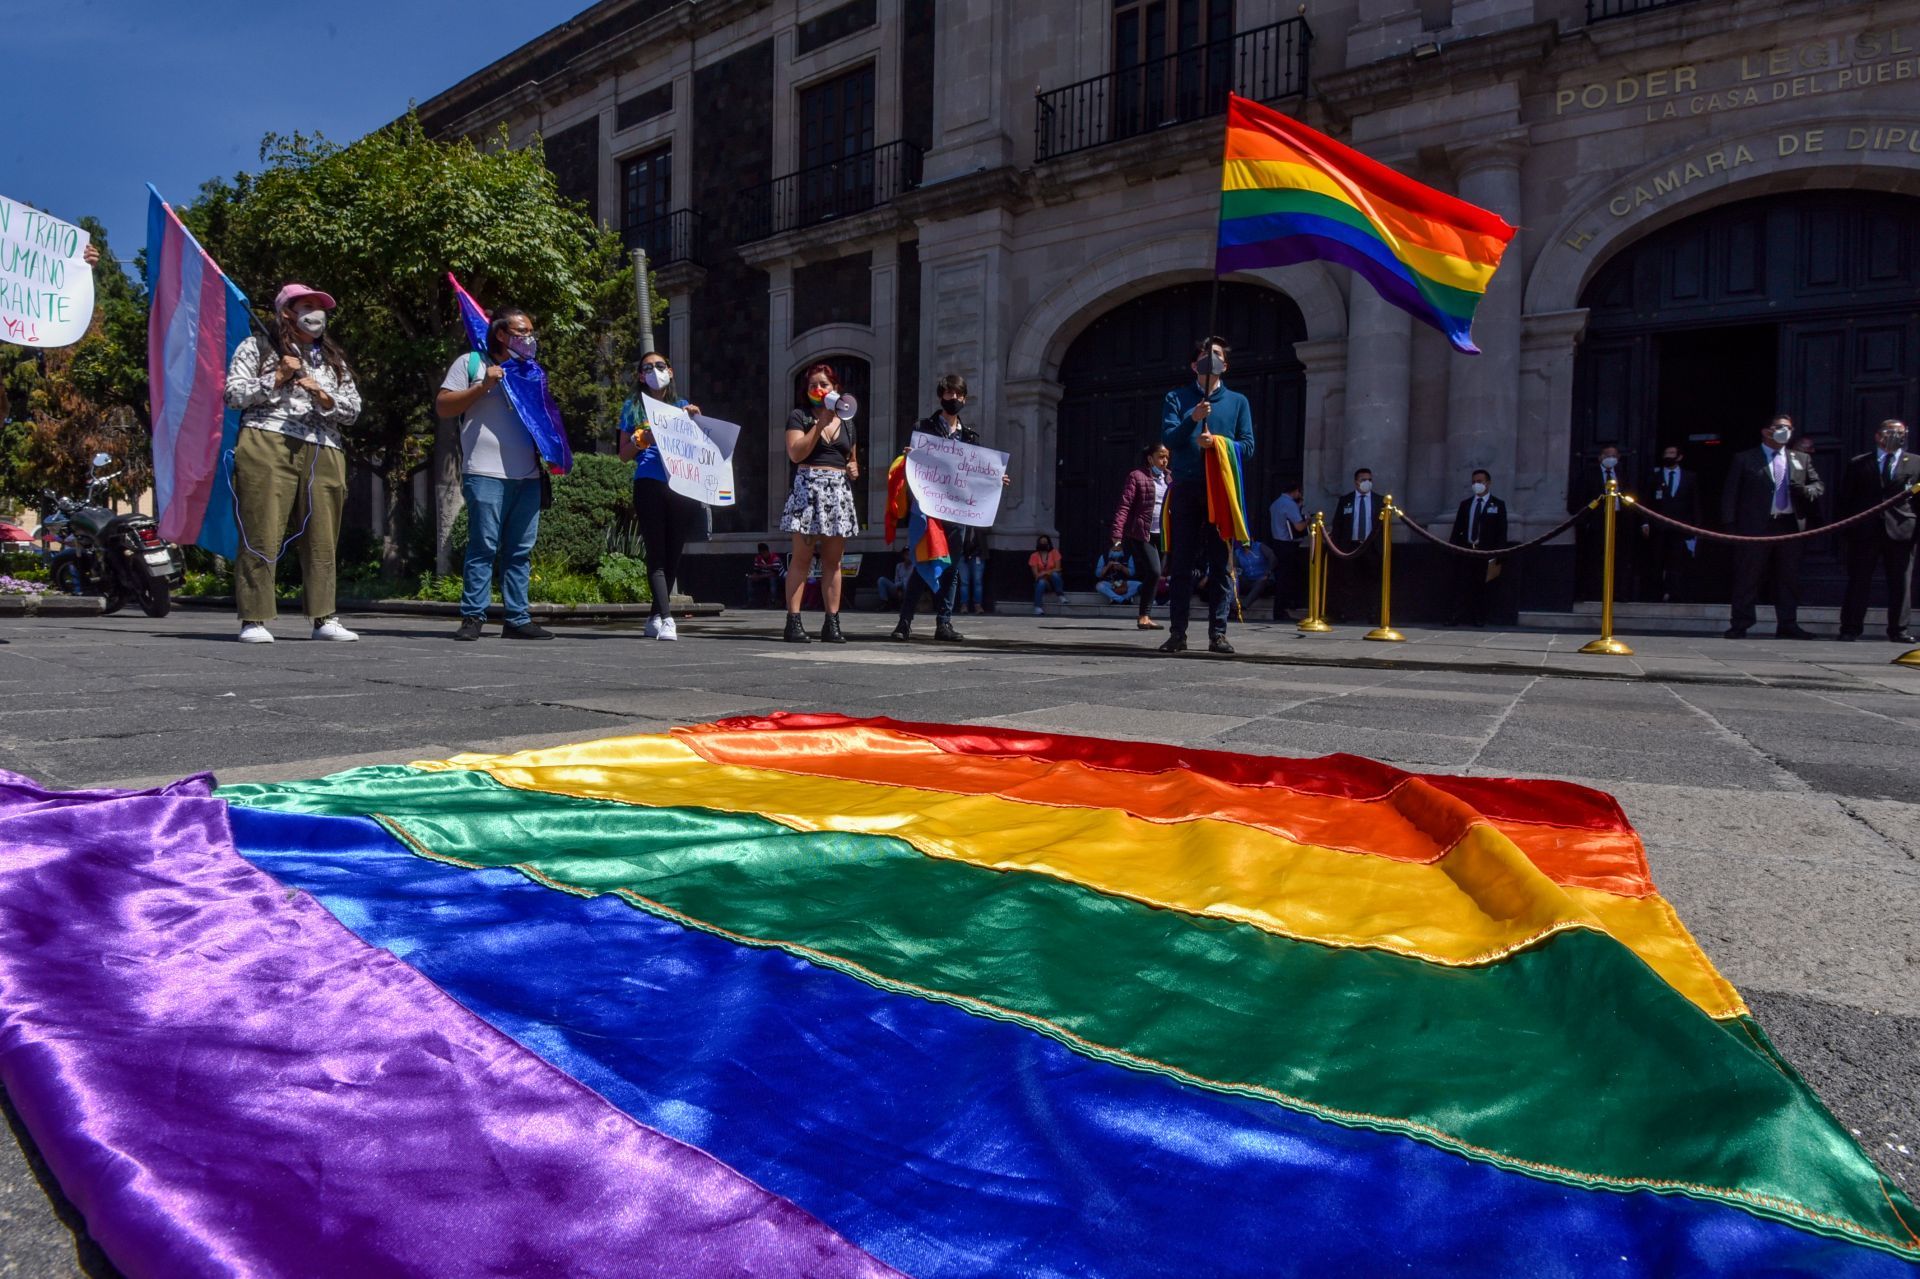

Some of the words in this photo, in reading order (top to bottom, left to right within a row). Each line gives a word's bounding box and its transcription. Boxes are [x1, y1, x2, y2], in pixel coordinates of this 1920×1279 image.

[1556, 66, 1698, 115] PODER
[1646, 102, 1677, 122] LA
[1690, 86, 1759, 115] CASA
[1772, 76, 1824, 101] DEL
[1838, 58, 1920, 90] PUEB
[1609, 144, 1755, 217] CAMARA
[1777, 129, 1826, 158] DE
[23, 211, 78, 259] TRATO
[3, 315, 40, 342] YA!
[666, 456, 701, 484] TORTURA
